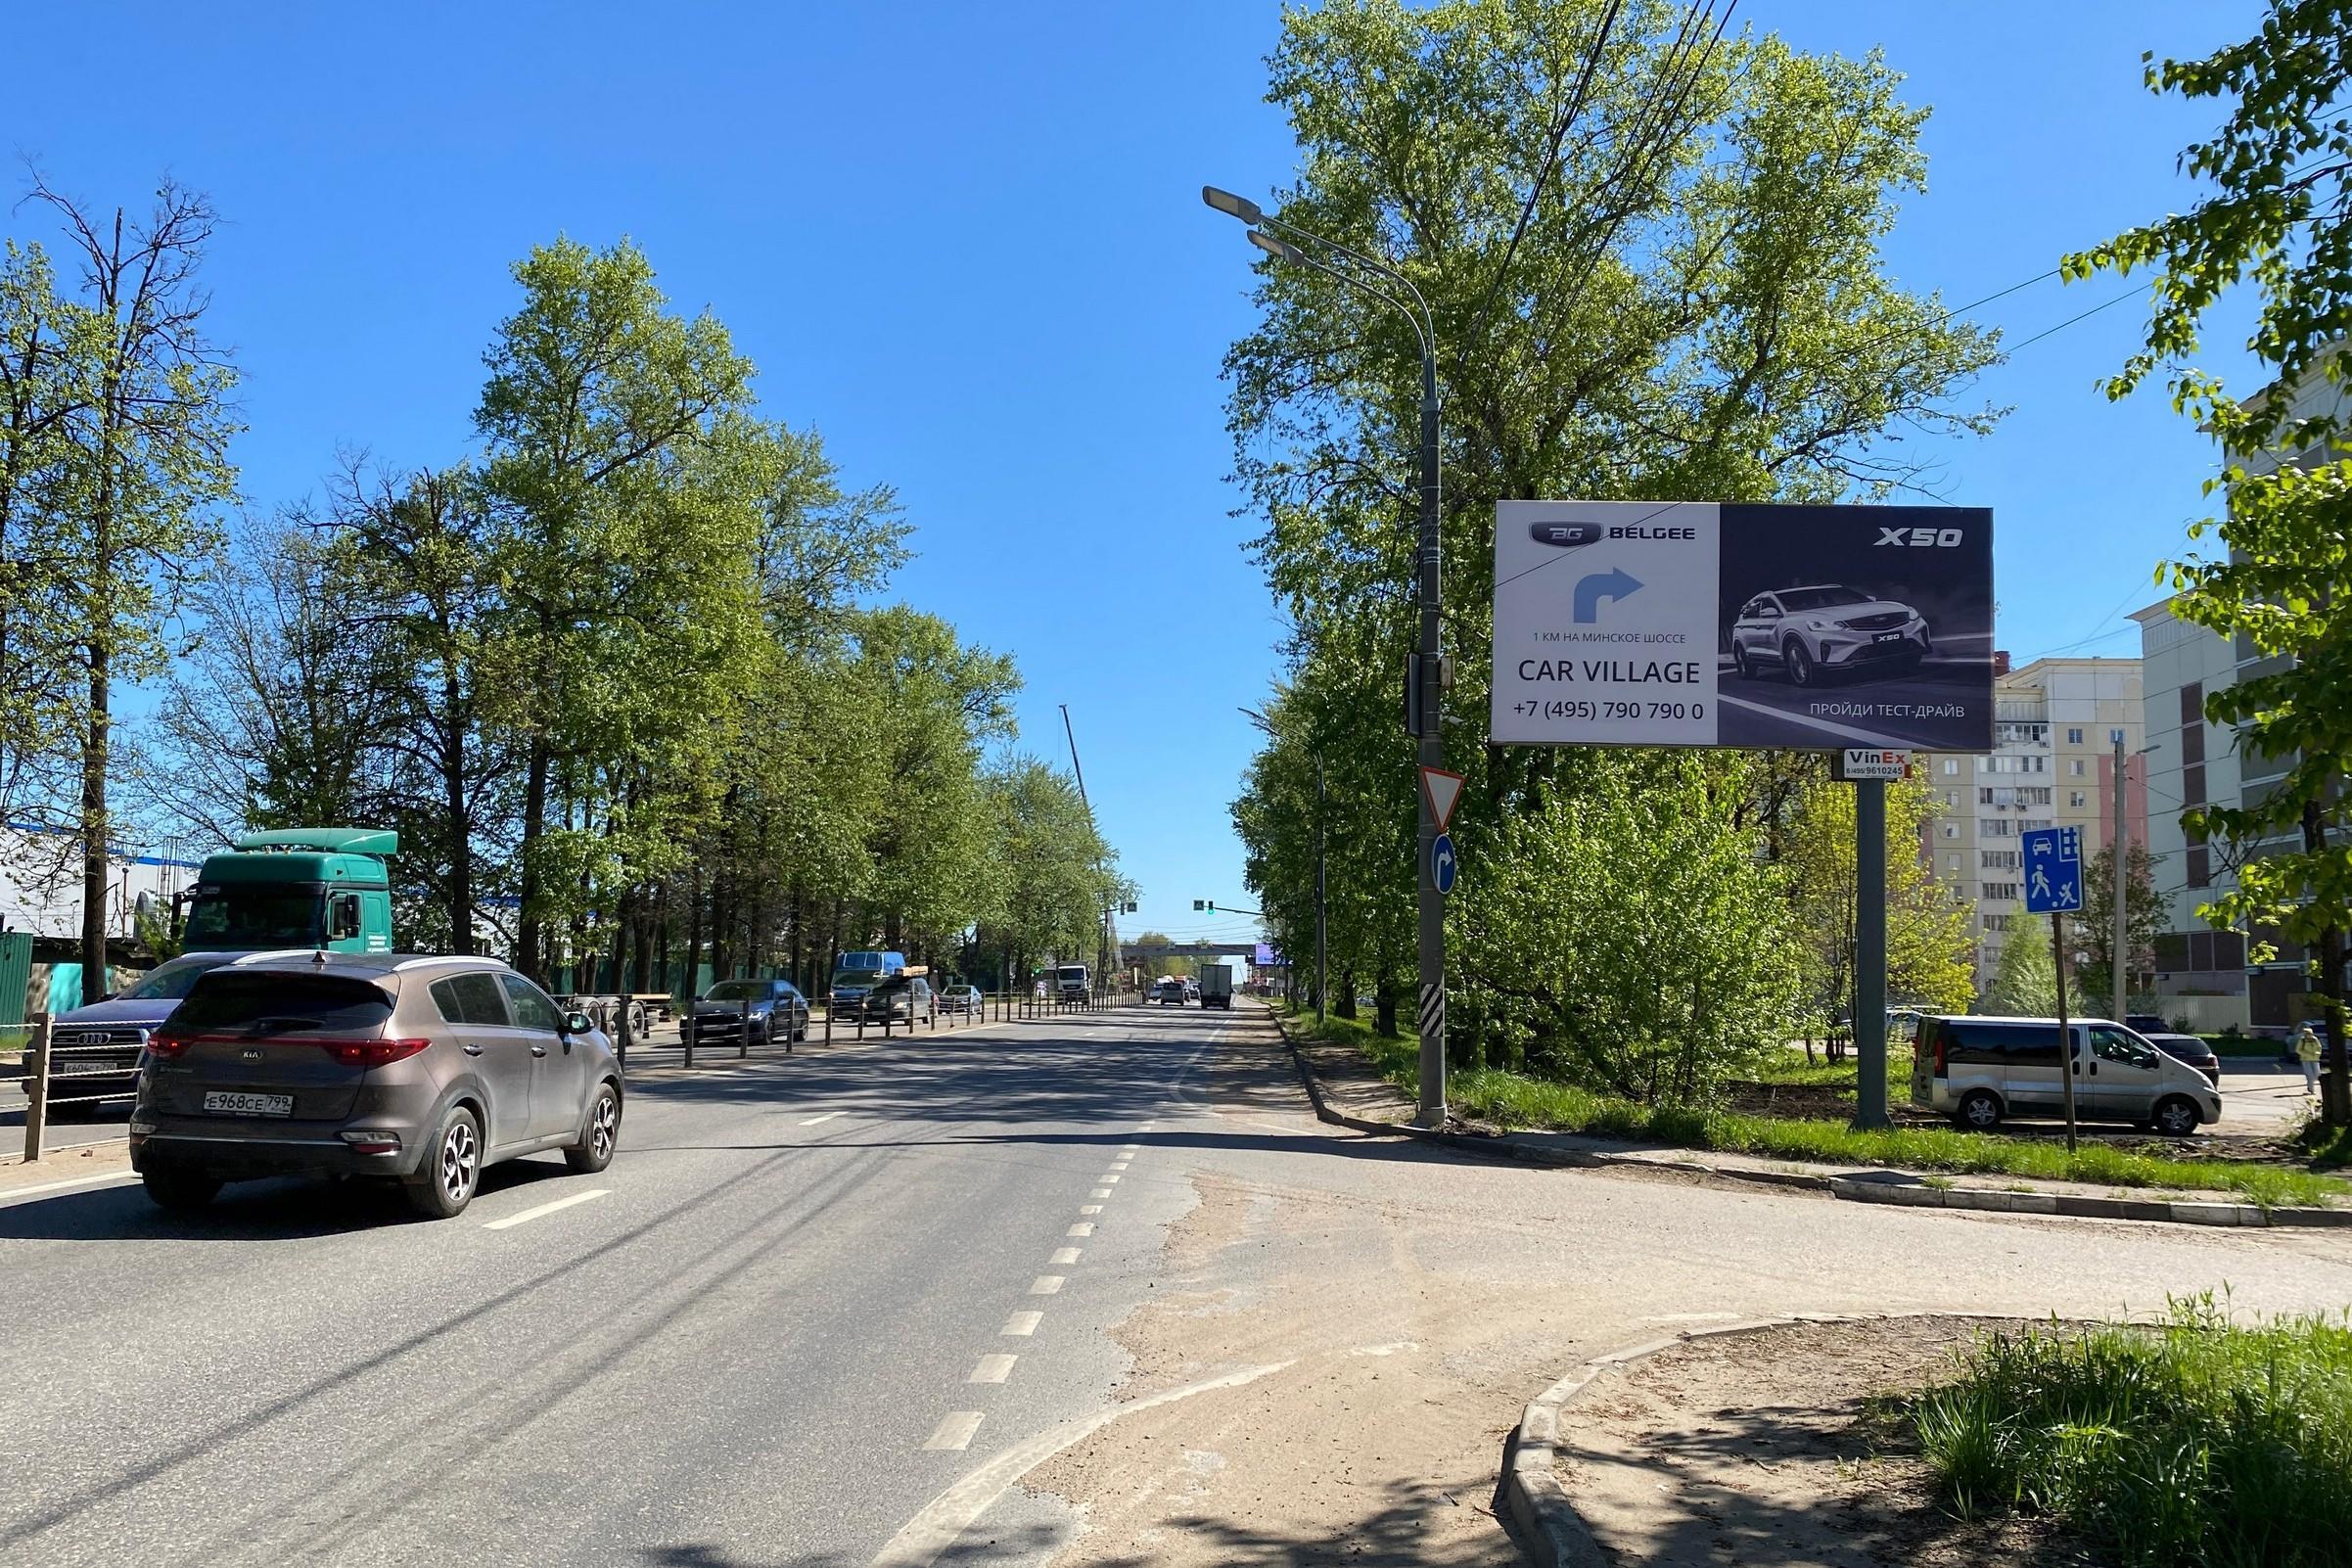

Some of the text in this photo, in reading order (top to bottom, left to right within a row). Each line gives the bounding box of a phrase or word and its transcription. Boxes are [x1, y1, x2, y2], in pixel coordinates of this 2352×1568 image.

[1609, 527, 1695, 539] BELGEE
[1872, 527, 1963, 547] X50
[1534, 632, 1686, 643] 1 КМ НА МИНСКОЕ ШОССЕ
[1518, 660, 1700, 683] CAR VILLAGE
[1513, 701, 1704, 720] +7 (495) 790 790 0
[1811, 702, 1965, 718] ПРОЙДИ ТЕСТ-ДРАЙВ
[1850, 751, 1905, 764] VinEx
